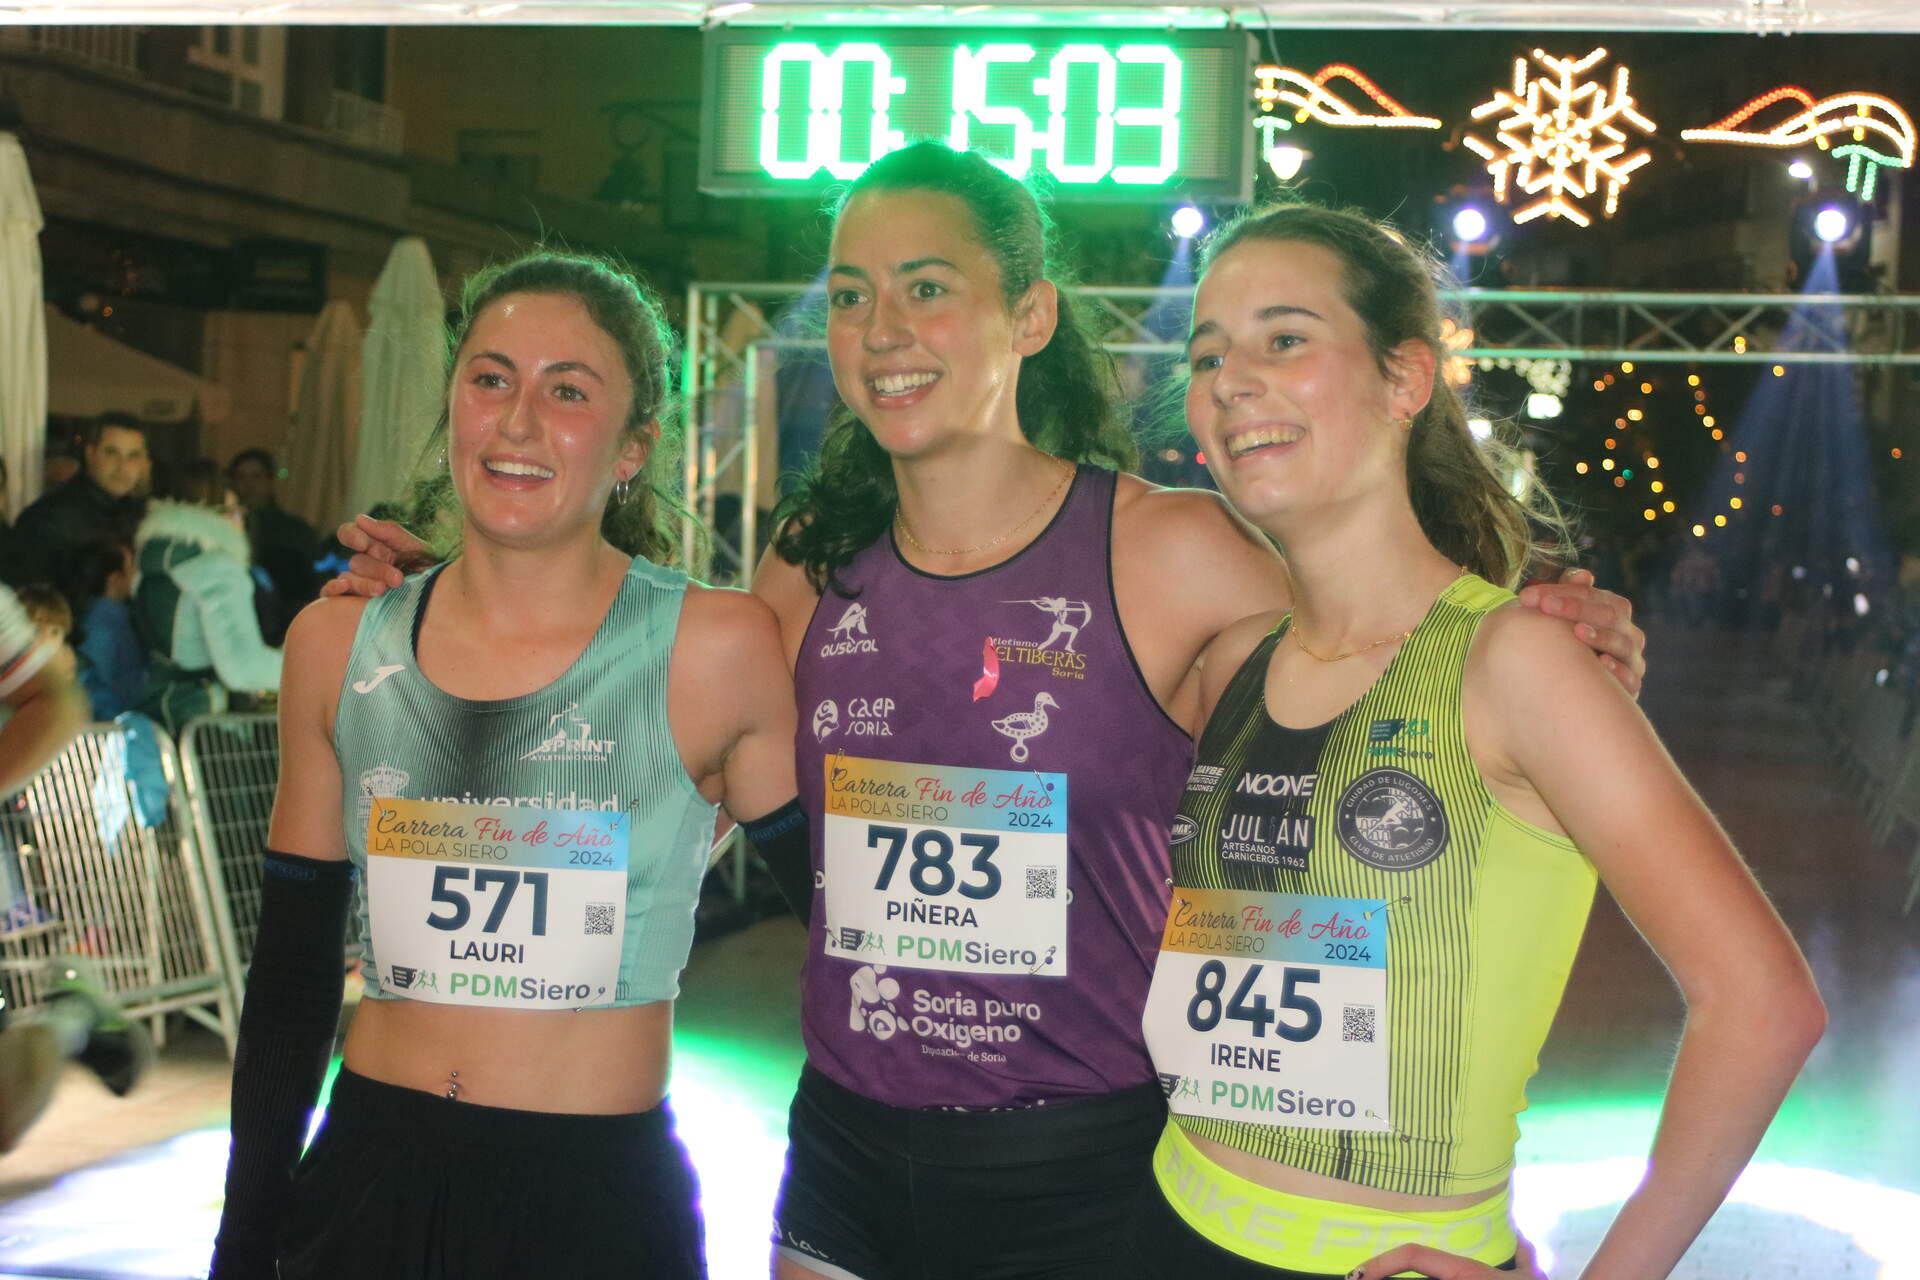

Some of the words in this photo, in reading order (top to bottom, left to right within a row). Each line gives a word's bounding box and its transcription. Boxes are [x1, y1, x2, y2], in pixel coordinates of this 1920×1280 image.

[821, 638, 879, 657] austral
[991, 637, 1039, 648] tletismo
[995, 645, 1087, 670] ELTIBERAS
[1051, 666, 1085, 680] Soria
[542, 738, 616, 753] SPRINT
[831, 768, 910, 799] Carrera
[914, 777, 955, 803] Fin
[961, 781, 988, 806] de
[991, 783, 1053, 810] Año
[1235, 772, 1317, 797] NOONE
[1346, 778, 1375, 808] CIUDAD
[1377, 776, 1391, 784] DE
[1393, 778, 1433, 812] LUGONES
[830, 795, 848, 810] LA
[850, 798, 892, 818] POLA
[896, 804, 949, 822] SIERO
[1008, 811, 1054, 828] 2024
[376, 809, 469, 840] Carrera
[474, 817, 515, 842] Fin
[521, 820, 549, 846] de
[552, 823, 616, 848] Año
[1221, 811, 1310, 848] JULÁN
[375, 837, 395, 852] LA
[400, 840, 447, 857] POLA
[452, 843, 508, 861] SIERO
[569, 850, 616, 866] 2024
[867, 823, 1003, 901] 783
[1221, 851, 1280, 865] CARNICEROS
[1282, 854, 1305, 868] 1962
[1222, 841, 1275, 855] ARTESANOS
[1349, 834, 1371, 855] CLUB
[1371, 850, 1385, 861] DE
[1387, 838, 1434, 863] ATLETISMO
[426, 865, 549, 937] 571
[886, 897, 979, 928] PIÑERA
[1174, 900, 1240, 931] Carrera
[1240, 905, 1273, 933] Fin
[1277, 908, 1303, 938] de
[1307, 911, 1371, 941] Año
[450, 940, 524, 964] LAURI
[896, 934, 1037, 967] PDMSiero
[1168, 932, 1185, 947] LA
[1189, 933, 1223, 949] POLA
[1226, 935, 1265, 953] SIERO
[1324, 943, 1372, 962] 2024
[450, 972, 590, 1001] PDMSiero
[912, 989, 977, 1018] Soria
[984, 998, 1041, 1024] puro
[1186, 959, 1323, 1043] 845
[967, 1051, 979, 1062] de
[981, 1052, 1007, 1062] Soria
[1210, 1043, 1281, 1073] IRENE
[1211, 1080, 1356, 1119] PDMSiero
[1165, 1148, 1297, 1252] NIKE
[1310, 1211, 1492, 1258] PRO
